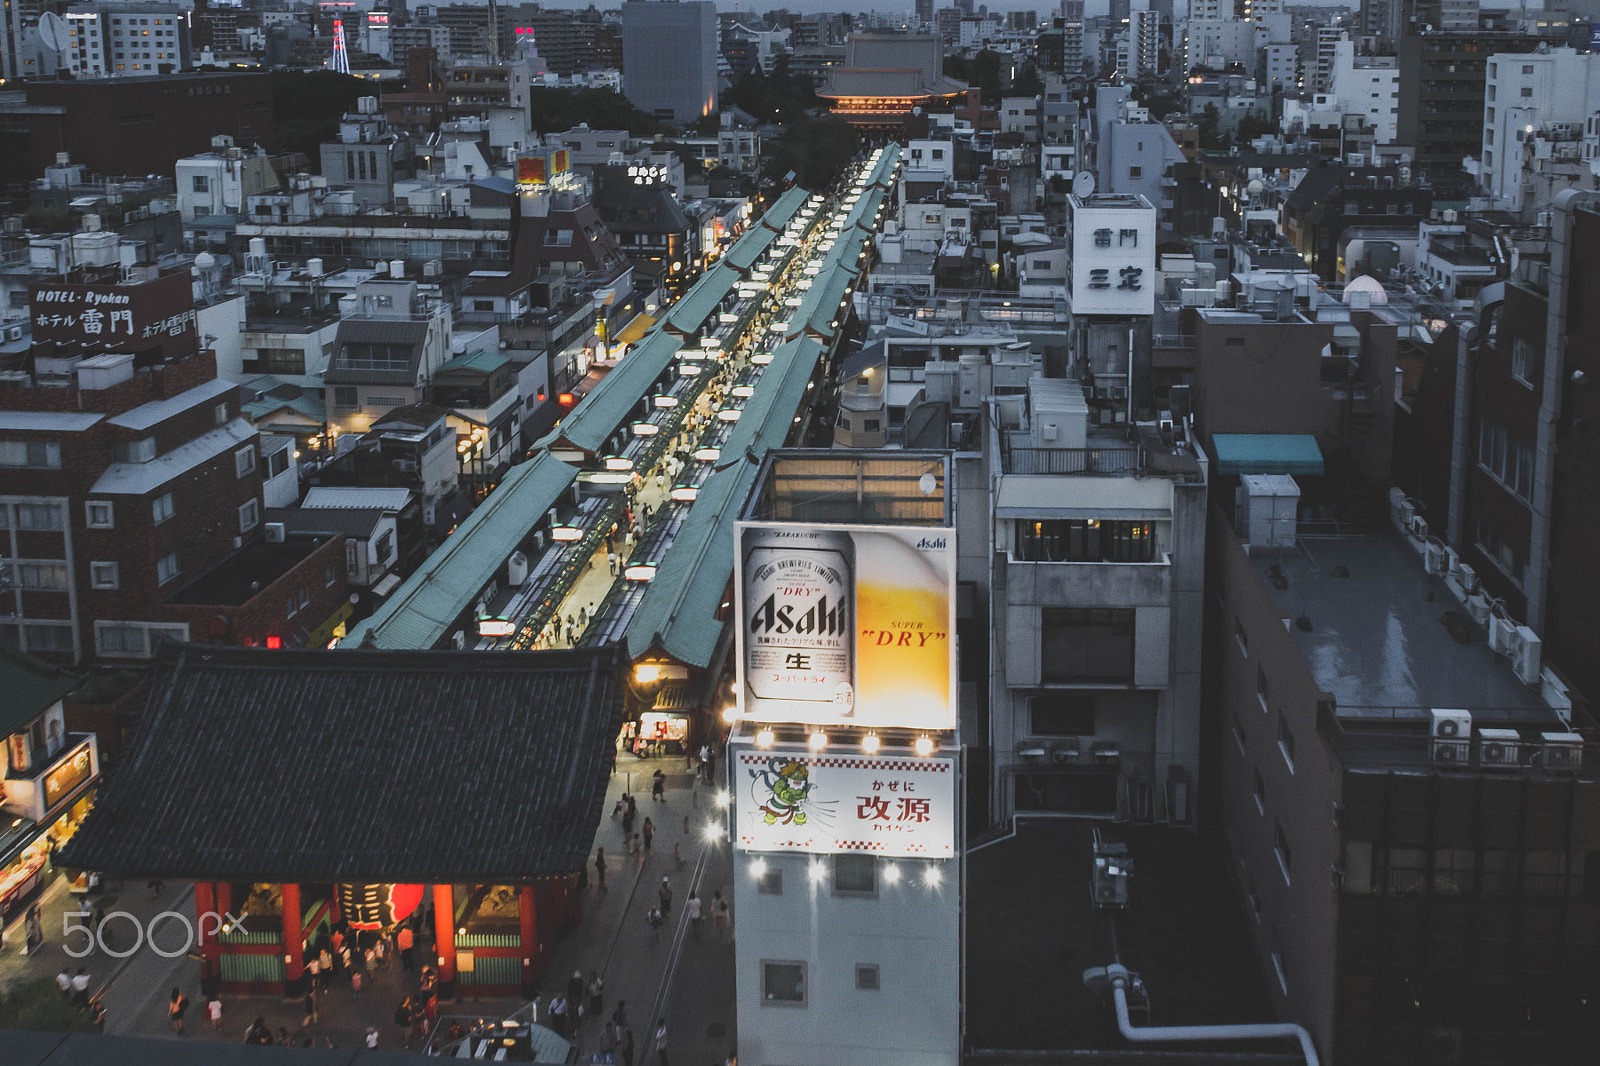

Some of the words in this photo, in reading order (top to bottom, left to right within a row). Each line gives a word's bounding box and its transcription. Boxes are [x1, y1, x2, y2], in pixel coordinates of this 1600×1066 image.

[1093, 228, 1138, 248] 雷門
[1088, 265, 1143, 292] 三定
[85, 291, 130, 306] Ryokan
[916, 537, 947, 549] Asahi
[778, 559, 813, 570] BREWERIES
[814, 565, 835, 585] LIMITED
[751, 593, 845, 637] Asahi
[891, 621, 924, 630] SUPER
[785, 652, 812, 670] 生
[872, 779, 915, 792] かぜに
[856, 795, 931, 823] 改源
